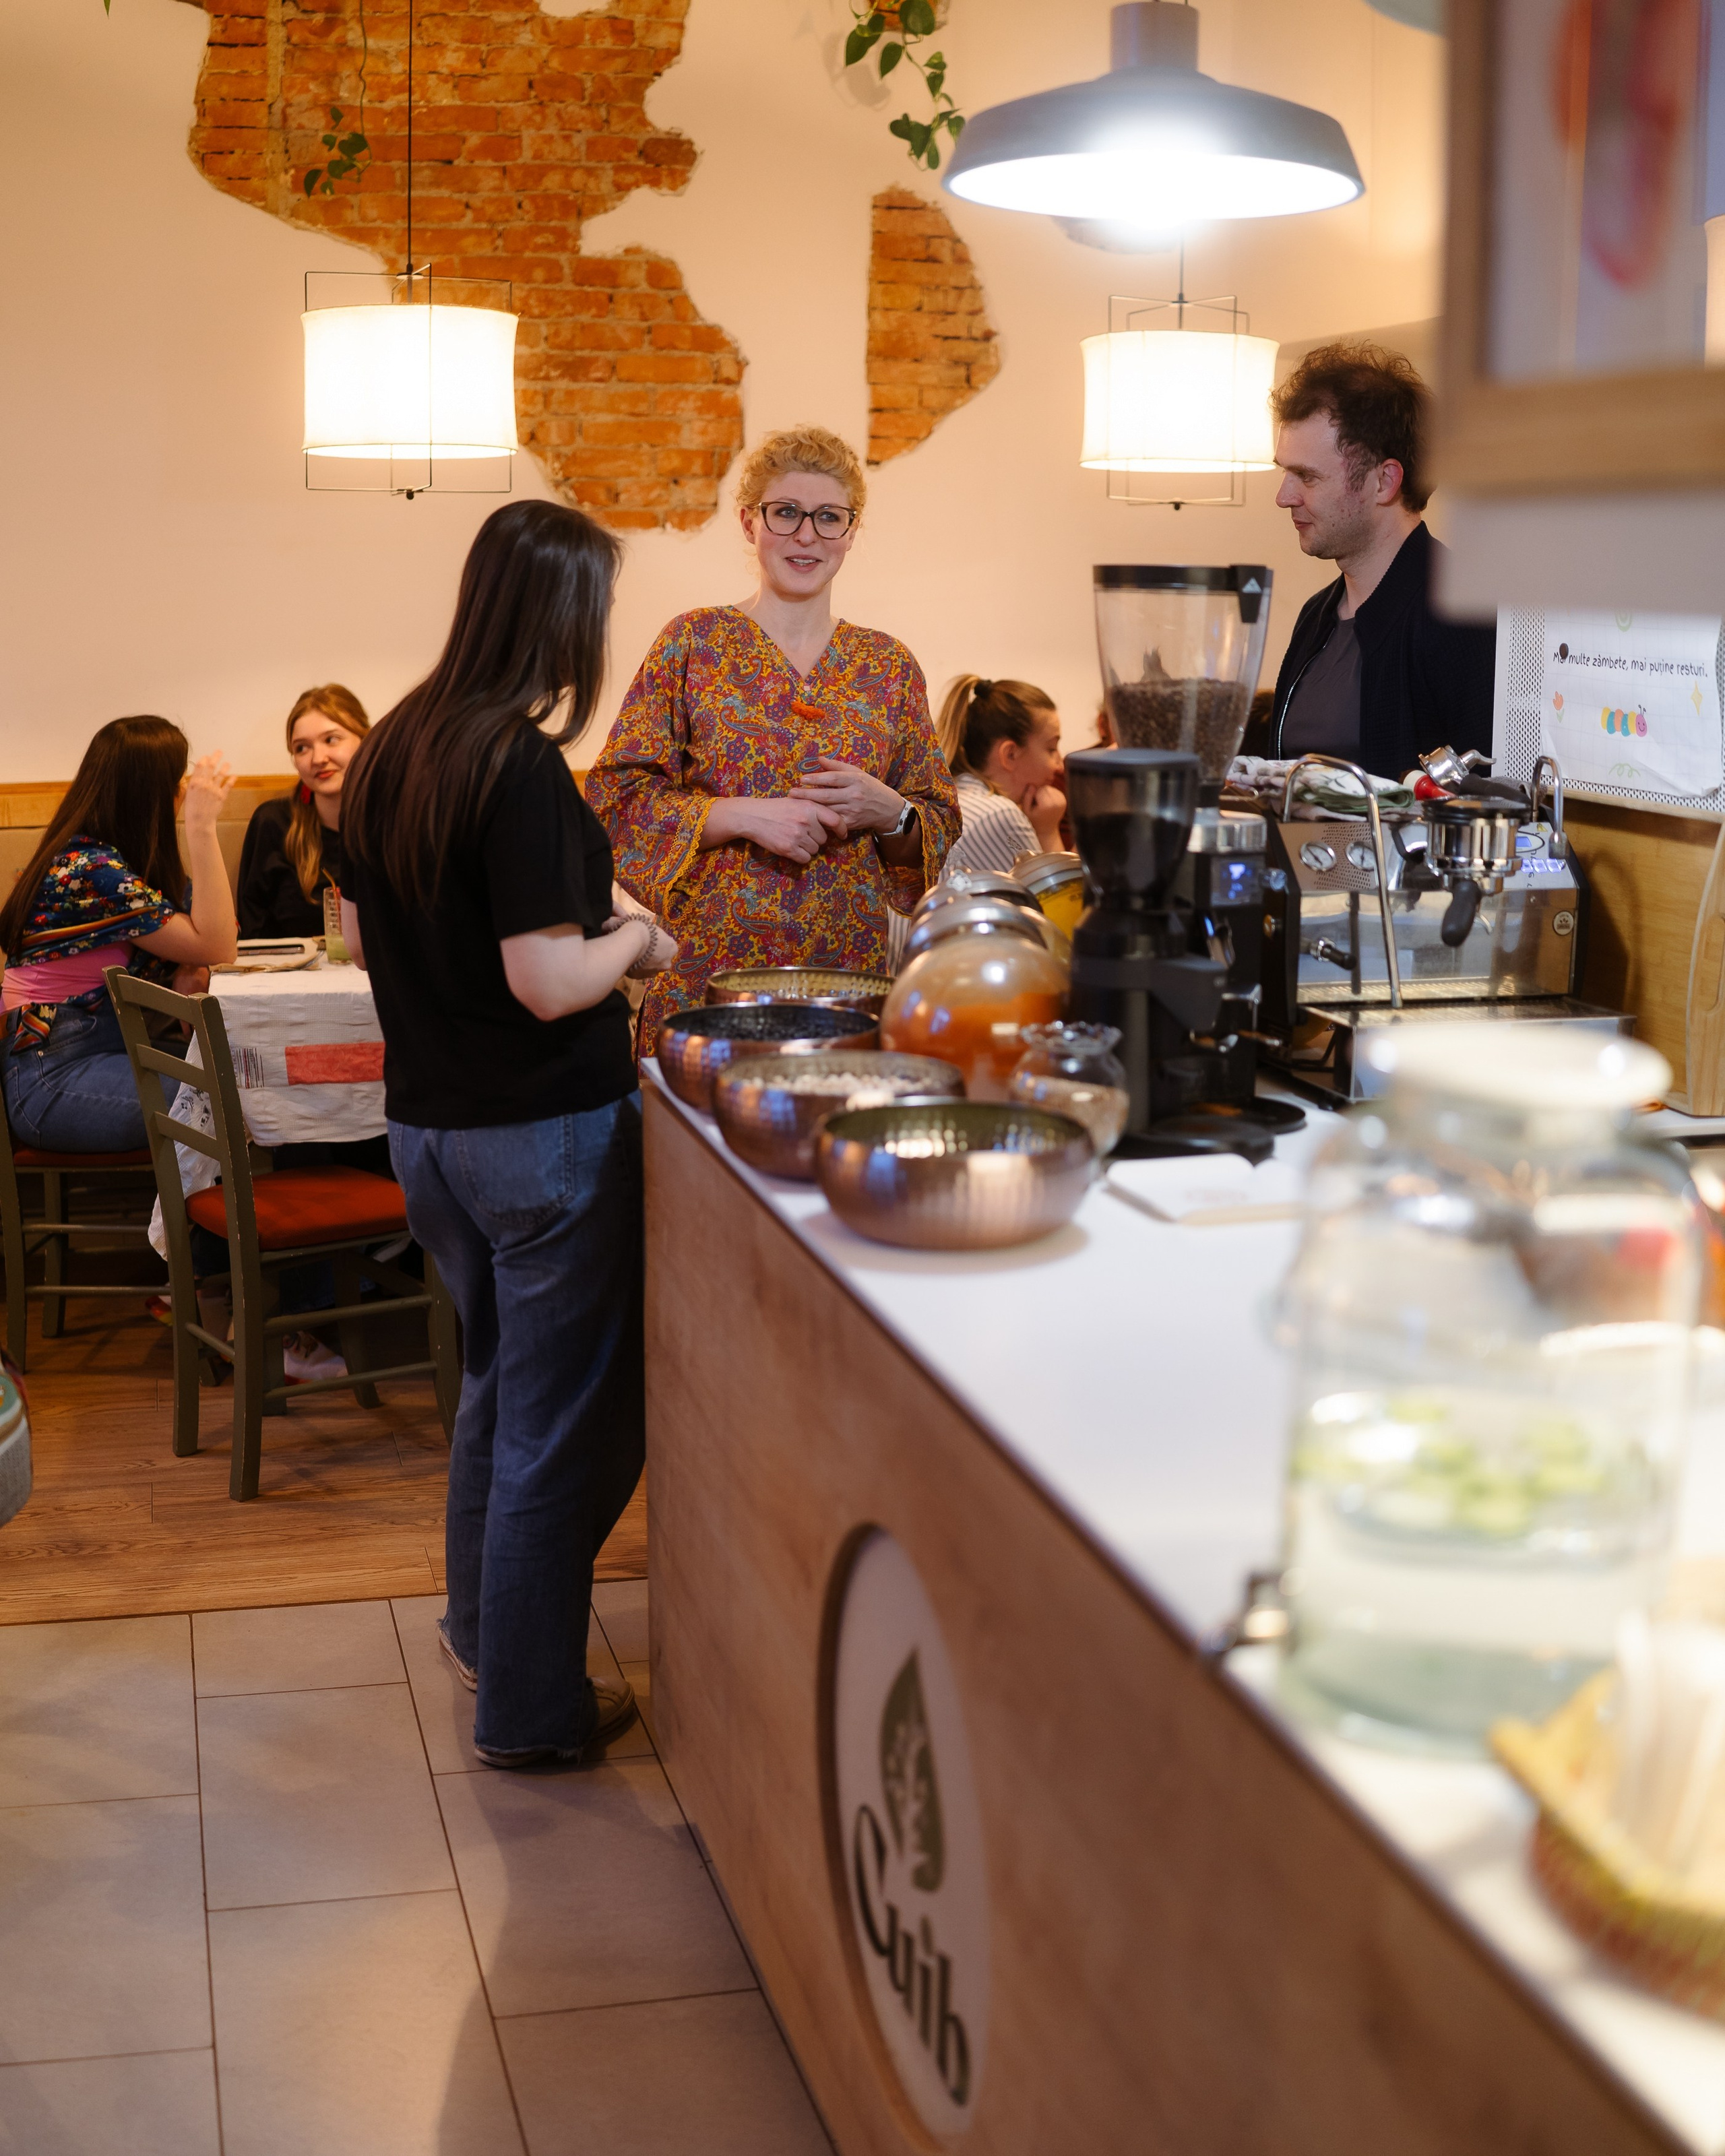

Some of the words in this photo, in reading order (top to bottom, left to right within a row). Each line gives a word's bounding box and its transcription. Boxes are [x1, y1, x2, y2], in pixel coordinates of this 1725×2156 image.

[1569, 653, 1590, 667] multe
[1631, 657, 1647, 671] mai
[1676, 662, 1707, 678] resturi.
[854, 1803, 972, 2107] Cuib
